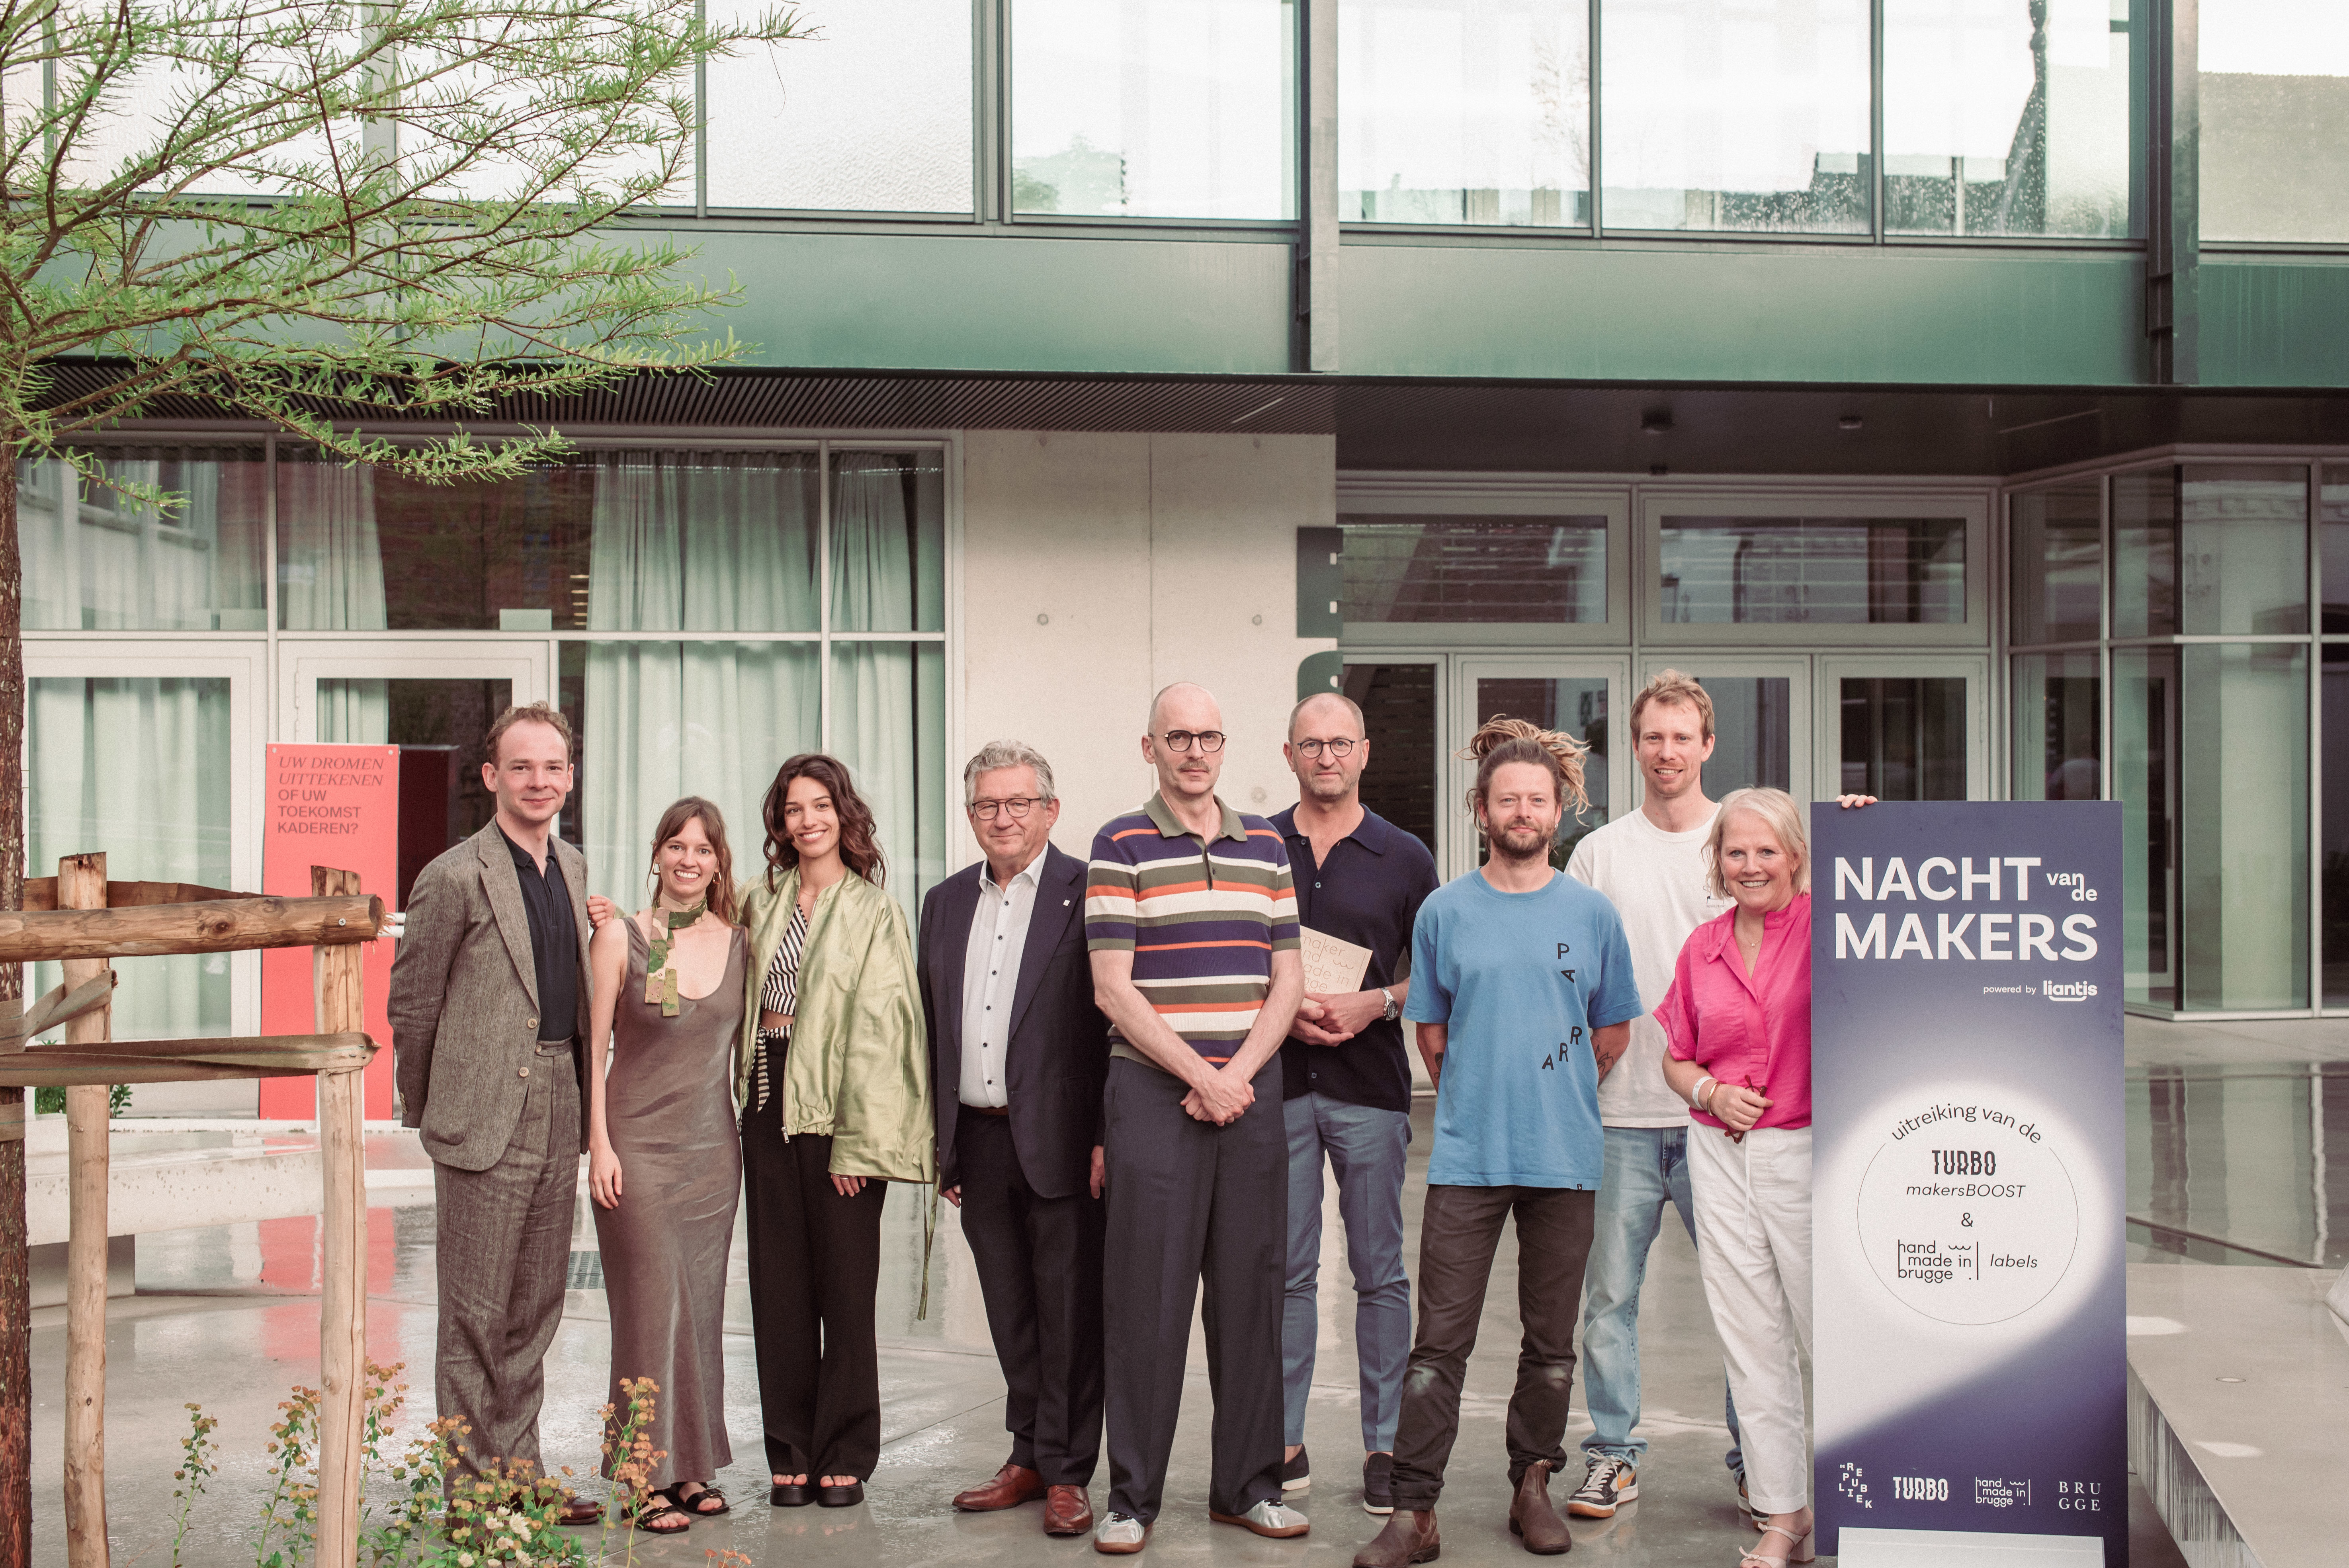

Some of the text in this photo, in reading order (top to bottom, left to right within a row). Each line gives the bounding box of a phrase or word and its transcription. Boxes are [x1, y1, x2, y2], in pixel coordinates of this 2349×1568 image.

[279, 756, 385, 770] UW DROMEN
[279, 773, 384, 787] UITTEKENEN
[278, 789, 327, 802] OF UW
[278, 805, 362, 818] TOEKOMST
[278, 822, 359, 834] KADEREN?
[1835, 857, 2084, 901] NACHT van
[2071, 881, 2097, 901] de
[1835, 913, 2098, 961] MAKERS
[1303, 964, 1349, 987] ade in
[1983, 980, 2098, 998] powered by liantis
[1892, 1103, 2041, 1143] uitreiking van de
[1931, 1150, 1996, 1176] TURBO
[1906, 1183, 2026, 1198] makersBOOST
[1961, 1212, 1974, 1227] &
[1898, 1240, 1936, 1254] hand
[1908, 1253, 1971, 1267] made in
[1990, 1254, 2038, 1268] labels
[1898, 1266, 1953, 1284] brugge
[1893, 1476, 1949, 1501] TURBO
[1975, 1476, 2002, 1488] hand
[1982, 1486, 2026, 1497] made in
[1975, 1496, 2013, 1508] brugge
